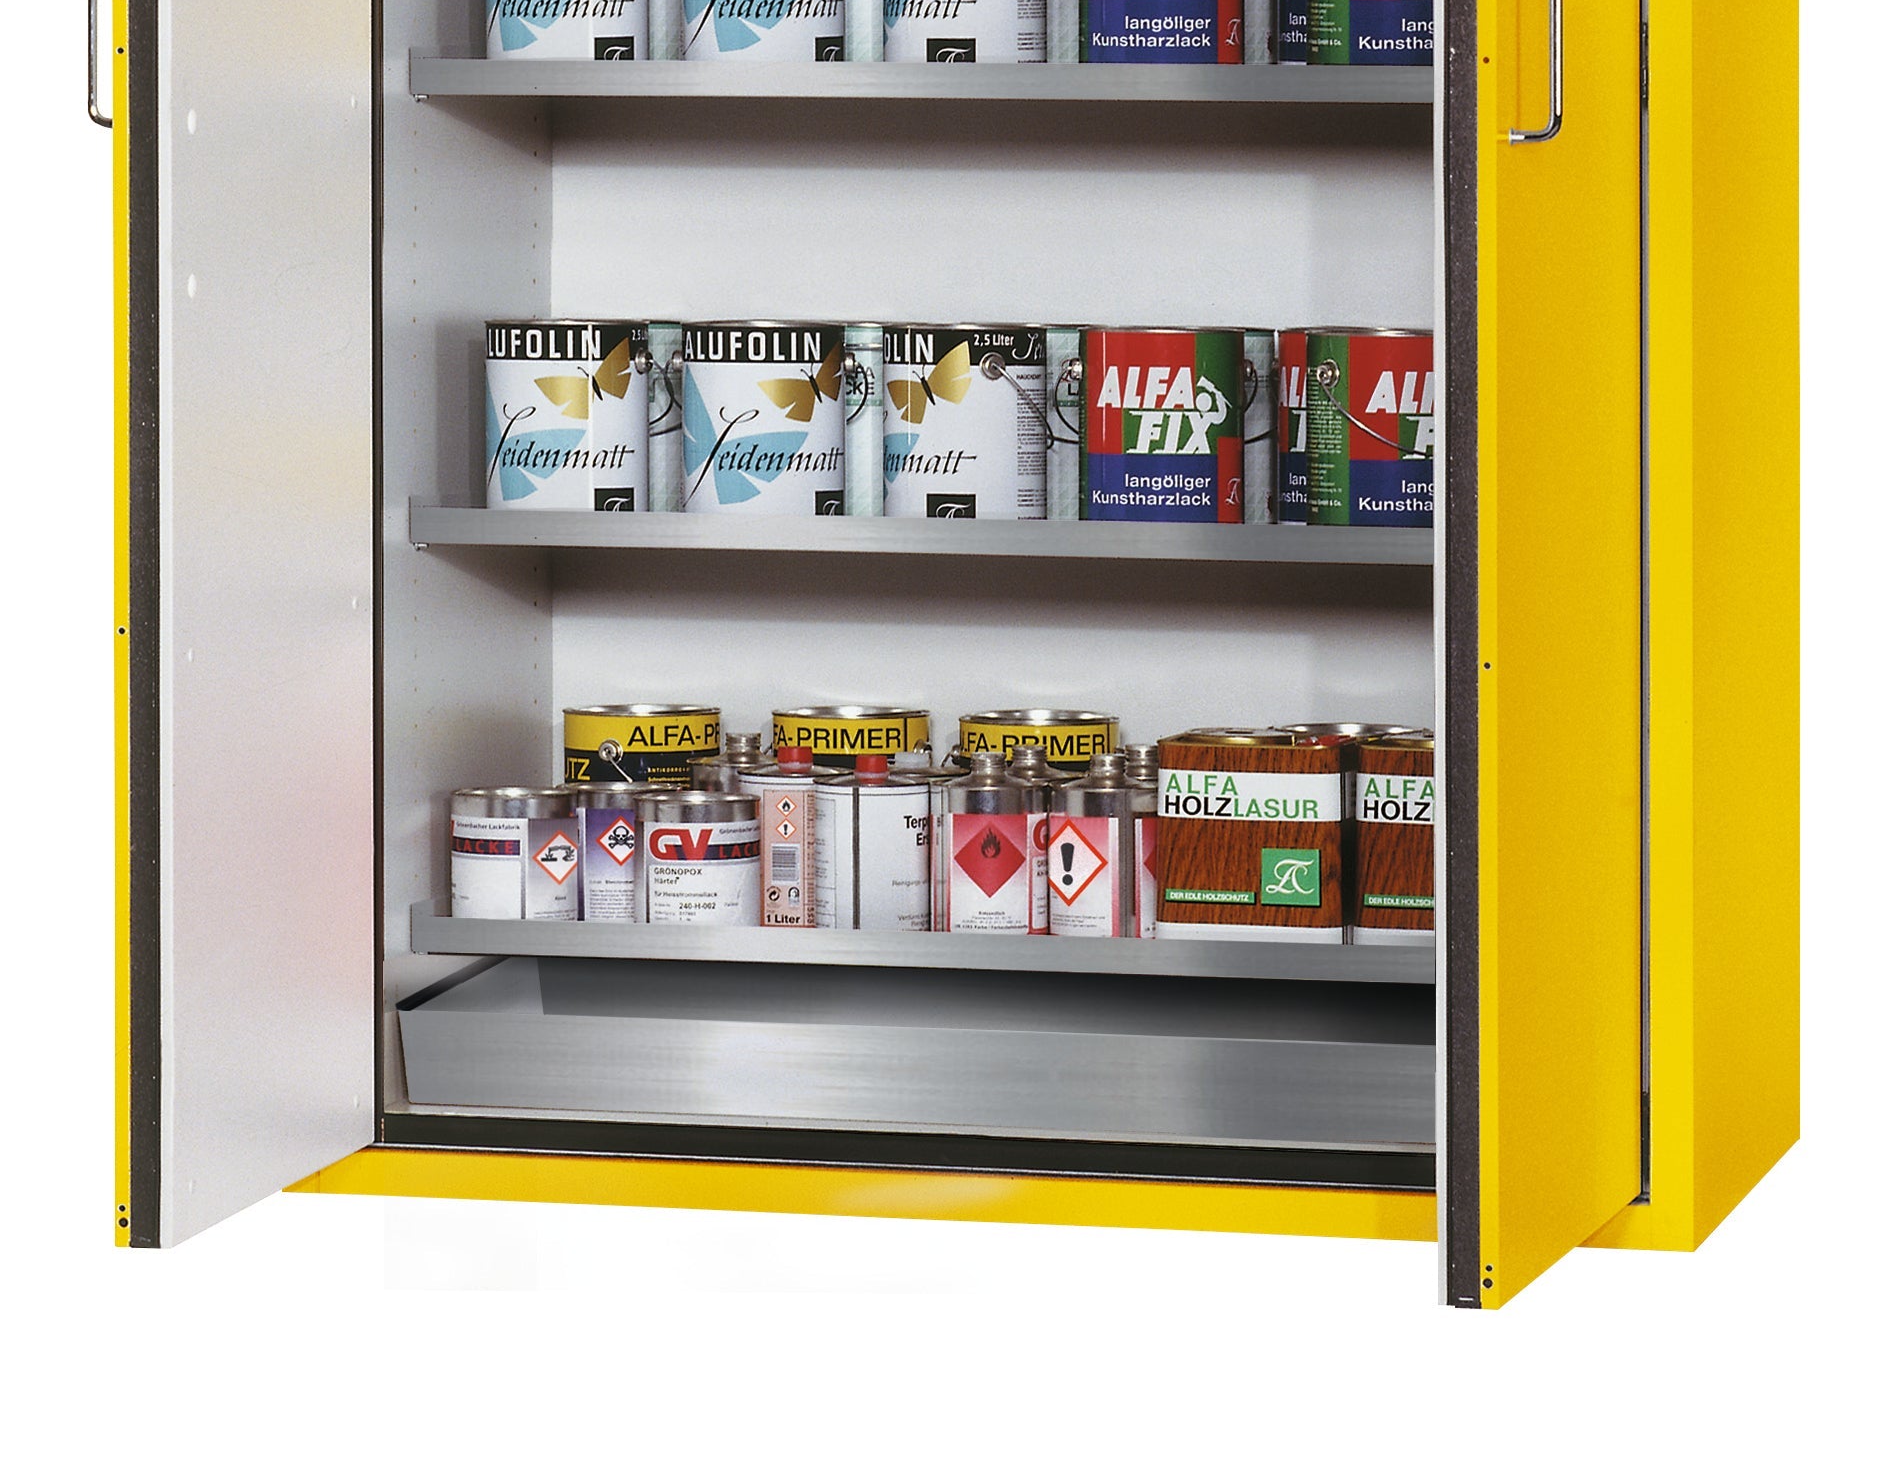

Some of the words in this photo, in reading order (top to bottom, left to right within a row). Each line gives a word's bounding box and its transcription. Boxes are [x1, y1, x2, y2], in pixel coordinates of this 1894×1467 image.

[1092, 33, 1211, 47] Kunstharzlack
[685, 331, 821, 361] ALUFOLIN
[974, 333, 991, 347] 2,5
[992, 333, 1014, 346] Liter
[1097, 366, 1195, 409] ALFA
[1126, 410, 1215, 454] FIX
[1092, 491, 1211, 505] Kunstharzlack
[1165, 773, 1238, 795] ALFA
[1364, 777, 1434, 800] ALFA
[1164, 795, 1319, 819] HOLZLASUR
[1363, 799, 1434, 822] HOLZ
[455, 839, 514, 854] LACKE
[649, 828, 713, 861] GV
[774, 914, 801, 924] Liter
